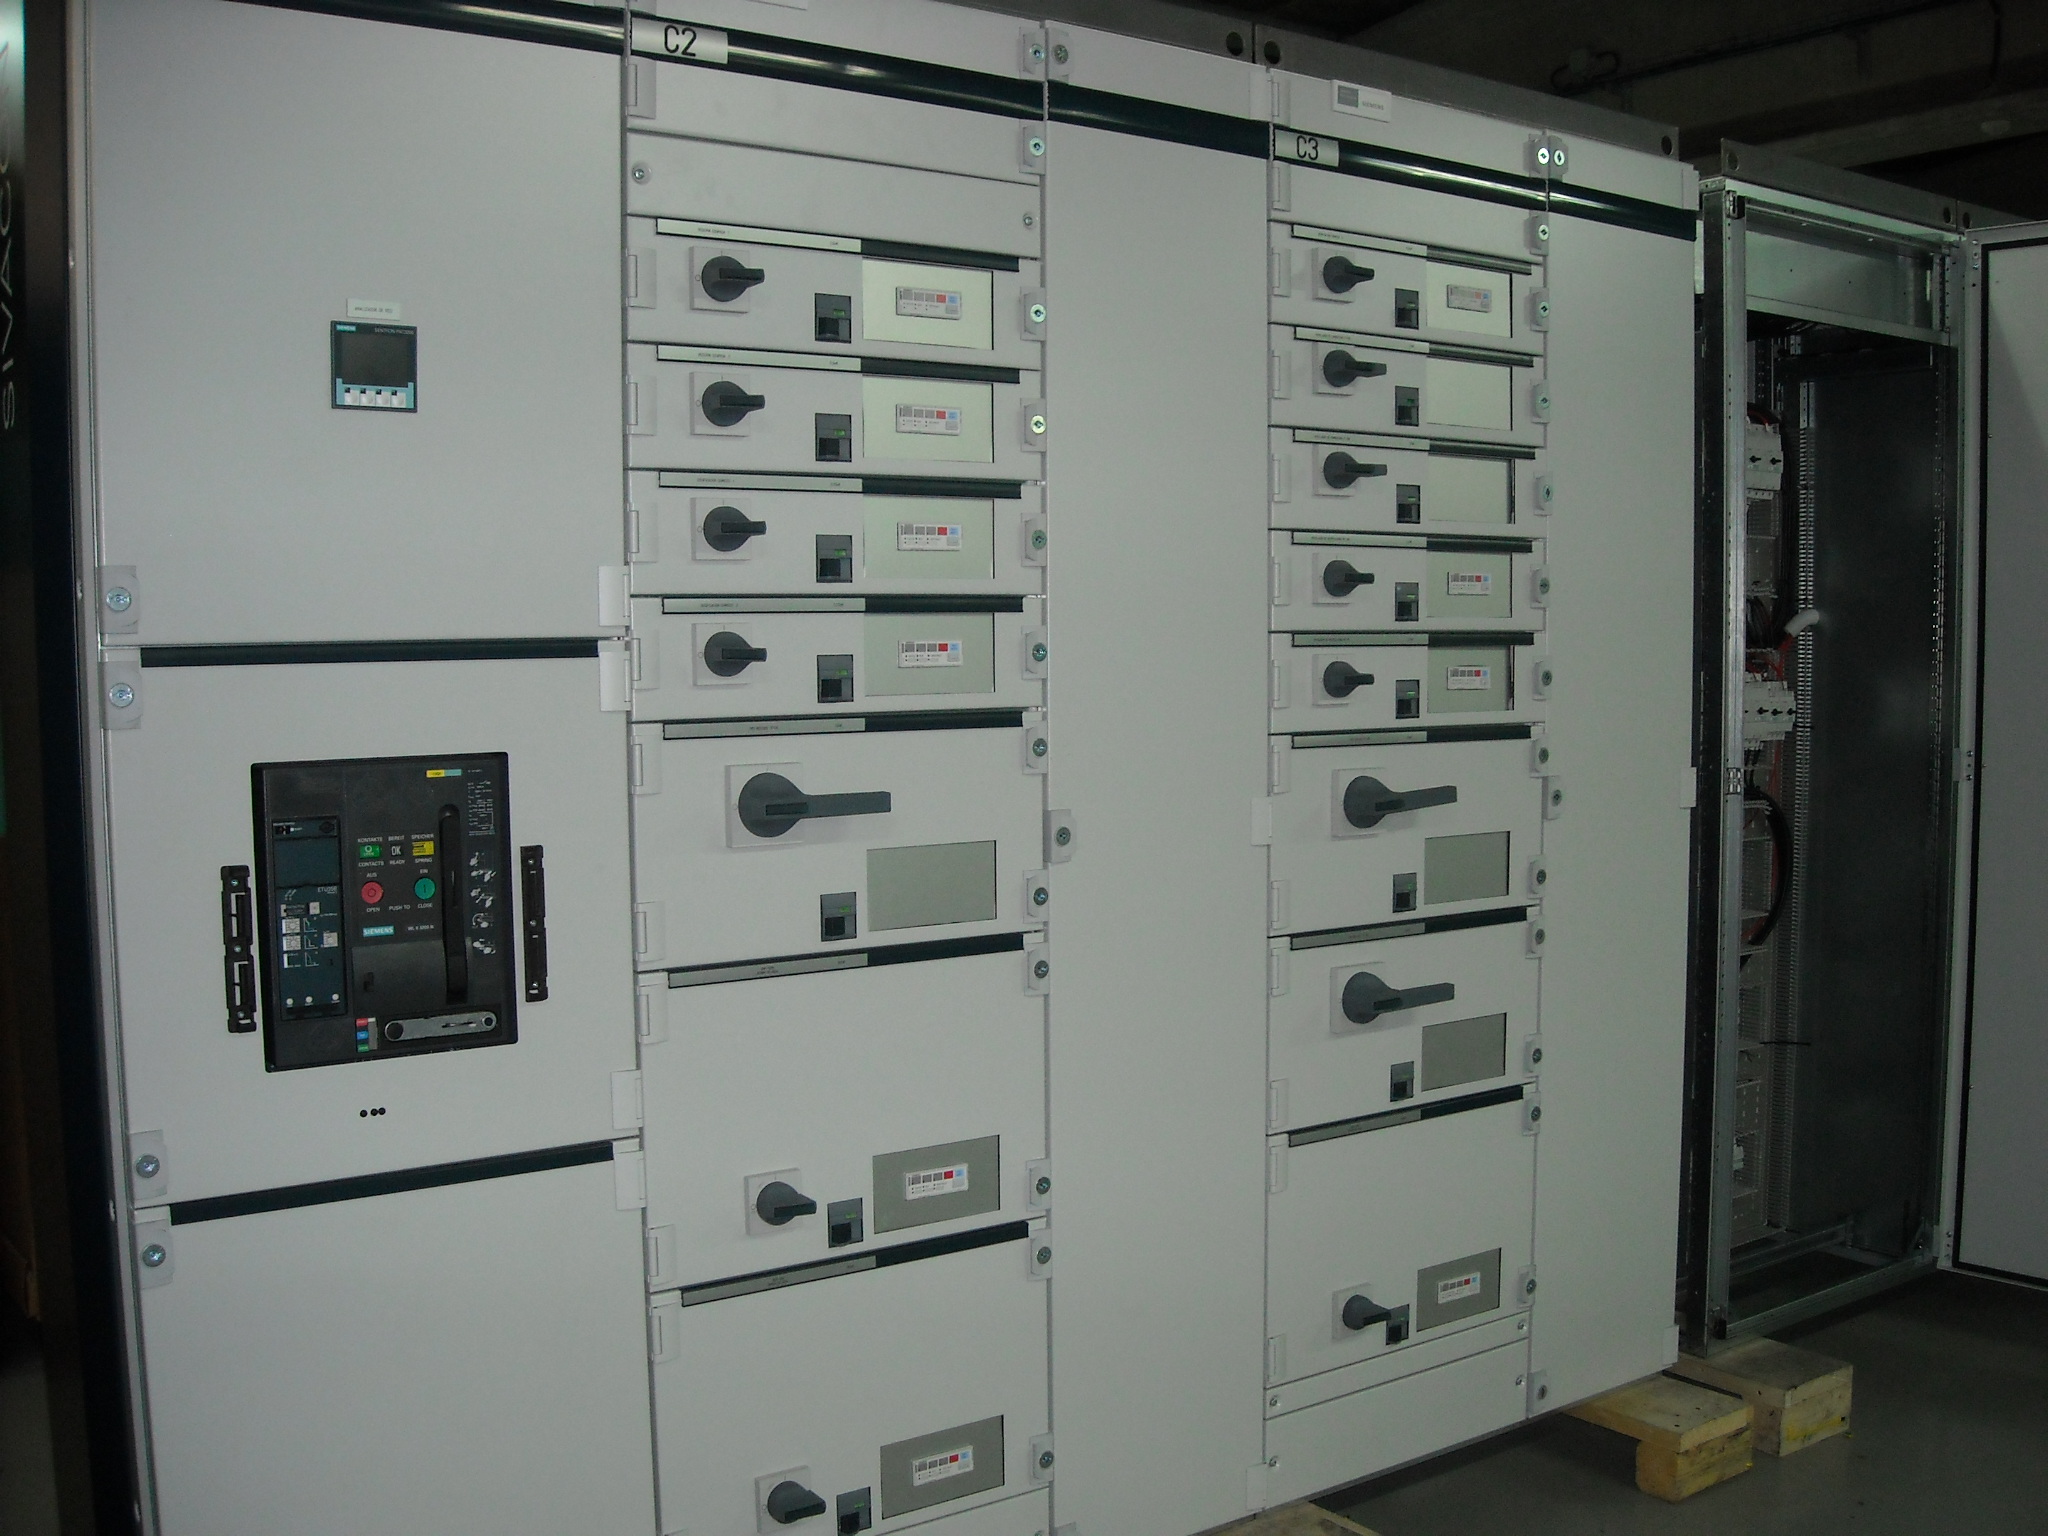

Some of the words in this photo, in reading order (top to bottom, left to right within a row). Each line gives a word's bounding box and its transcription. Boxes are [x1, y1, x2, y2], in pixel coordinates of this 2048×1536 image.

[664, 24, 698, 57] C2
[1296, 135, 1319, 161] C3
[391, 845, 402, 856] OK
[363, 927, 394, 937] SIEMENS
